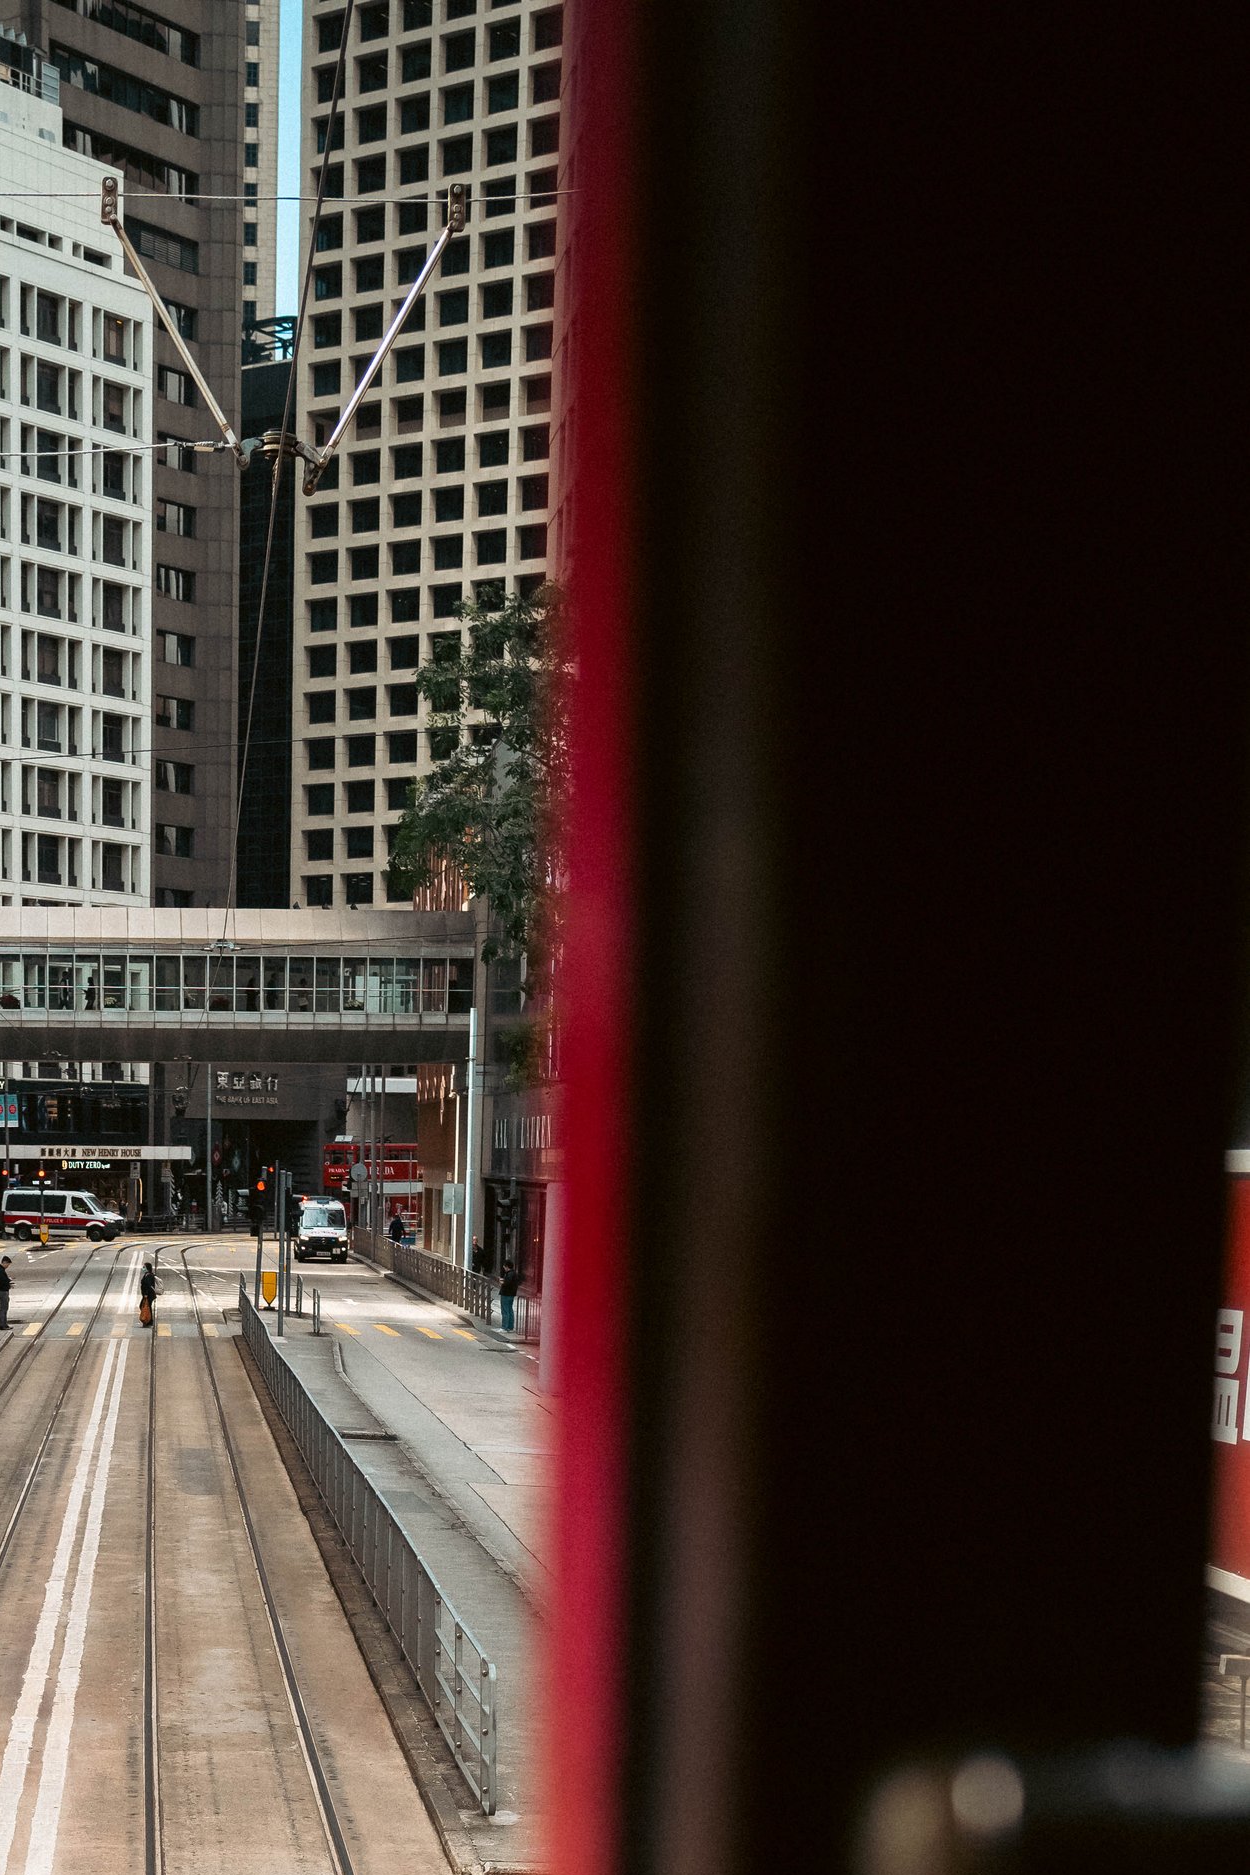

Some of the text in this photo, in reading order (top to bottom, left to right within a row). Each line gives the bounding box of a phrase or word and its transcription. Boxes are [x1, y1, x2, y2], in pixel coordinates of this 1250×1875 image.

[216, 1071, 279, 1091] 東亞銀行
[251, 1096, 265, 1104] EAST
[266, 1096, 279, 1105] ASIA
[82, 1148, 96, 1157] NEW
[98, 1148, 119, 1157] HENRY
[121, 1149, 142, 1157] HOUSE
[68, 1161, 84, 1169] DUTY
[85, 1161, 101, 1169] ZERO
